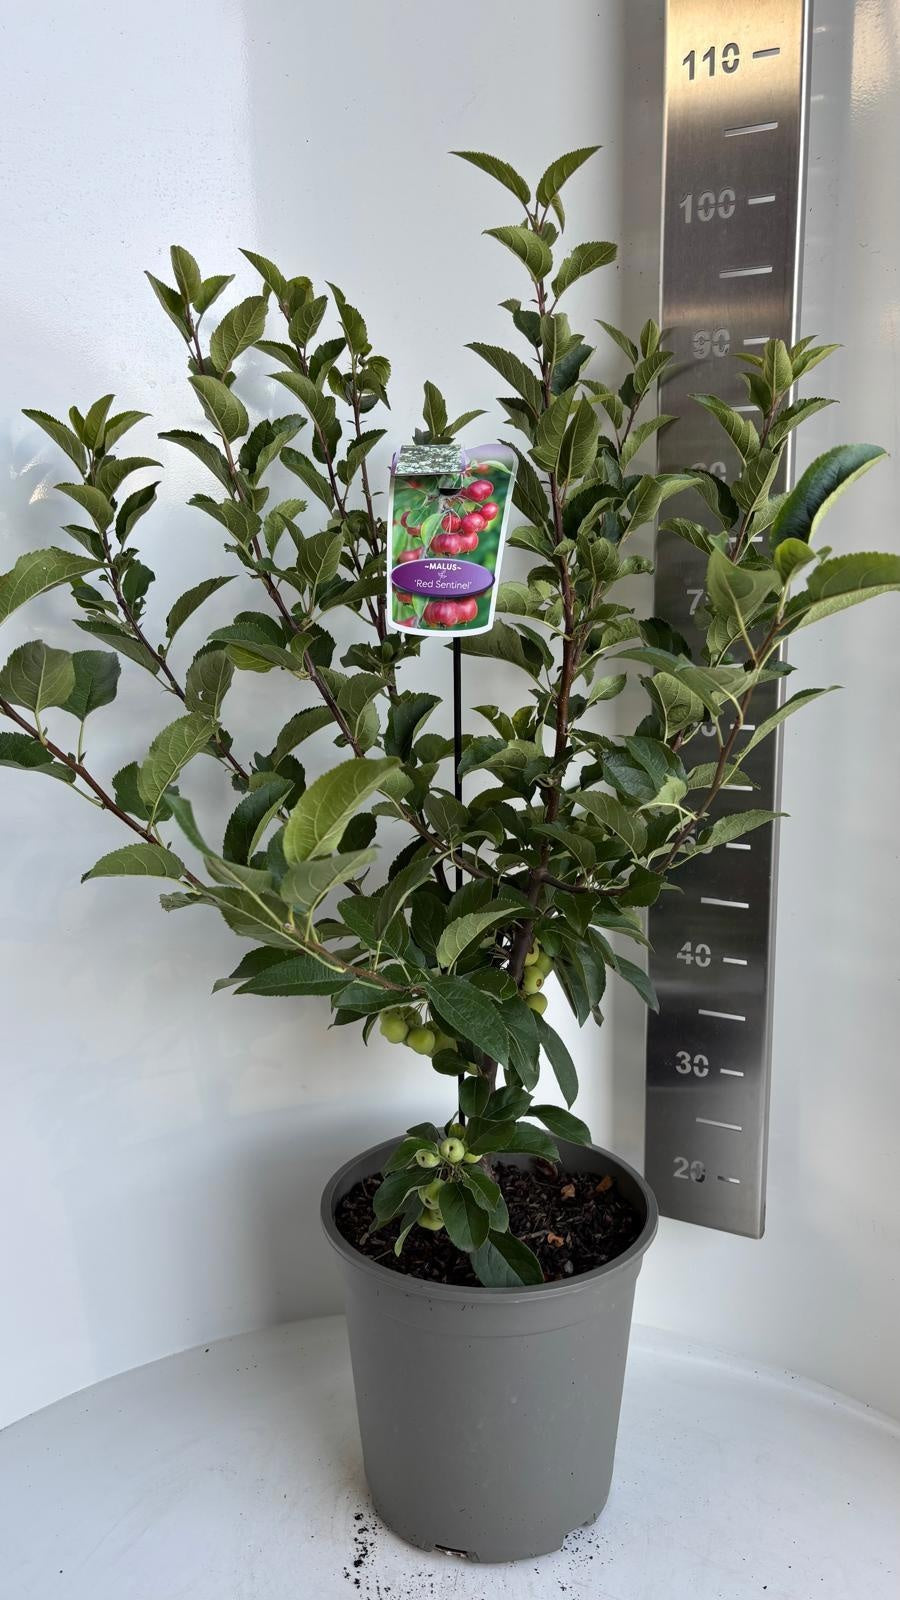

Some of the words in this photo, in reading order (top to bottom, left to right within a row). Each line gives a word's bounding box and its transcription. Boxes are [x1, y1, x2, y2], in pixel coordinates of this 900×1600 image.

[682, 42, 740, 80] 110
[679, 188, 736, 223] 100
[676, 941, 712, 968] 40
[675, 1050, 710, 1078] 30
[673, 1156, 706, 1184] 20
